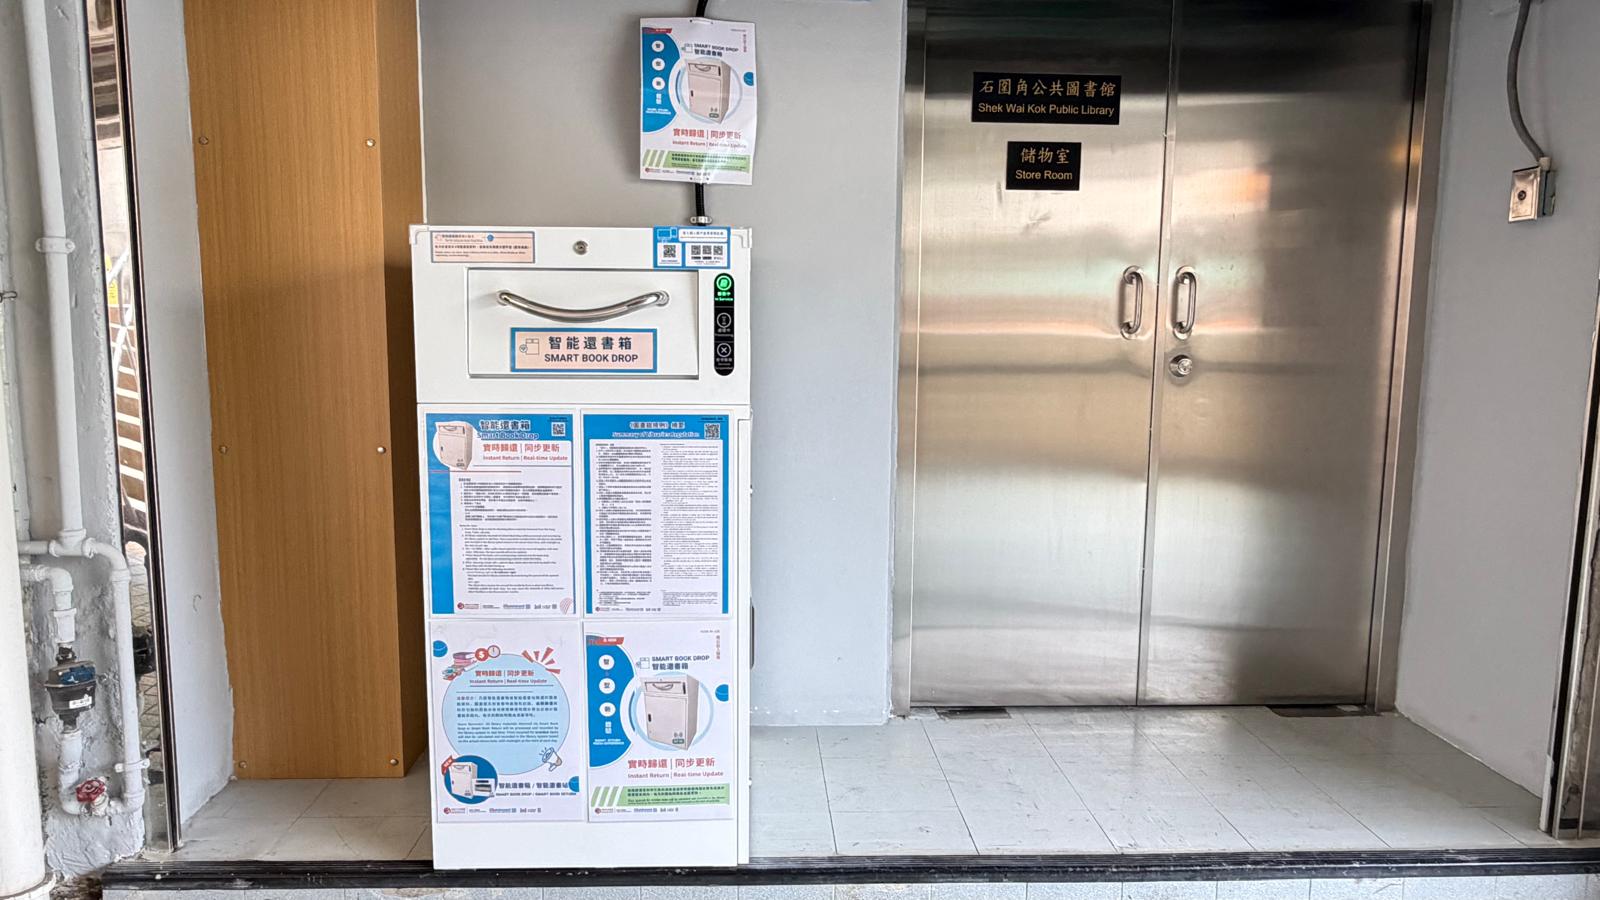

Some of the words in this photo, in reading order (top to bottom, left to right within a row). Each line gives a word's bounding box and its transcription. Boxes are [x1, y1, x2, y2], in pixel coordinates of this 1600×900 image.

[979, 79, 1116, 98] 石圍角公共圖書館
[978, 103, 1003, 113] Shek
[1006, 103, 1025, 114] Wai
[1028, 104, 1046, 114] Kok
[1049, 104, 1079, 115] Public
[1082, 105, 1114, 117] Library
[1021, 147, 1070, 165] 儲物室
[1015, 170, 1041, 179] Store
[1044, 170, 1073, 180] Room
[548, 336, 632, 350] 智能還書箱
[544, 354, 579, 363] SMART
[582, 354, 609, 362] BOOK
[611, 354, 638, 362] DROP
[675, 757, 715, 768] 同步更新
